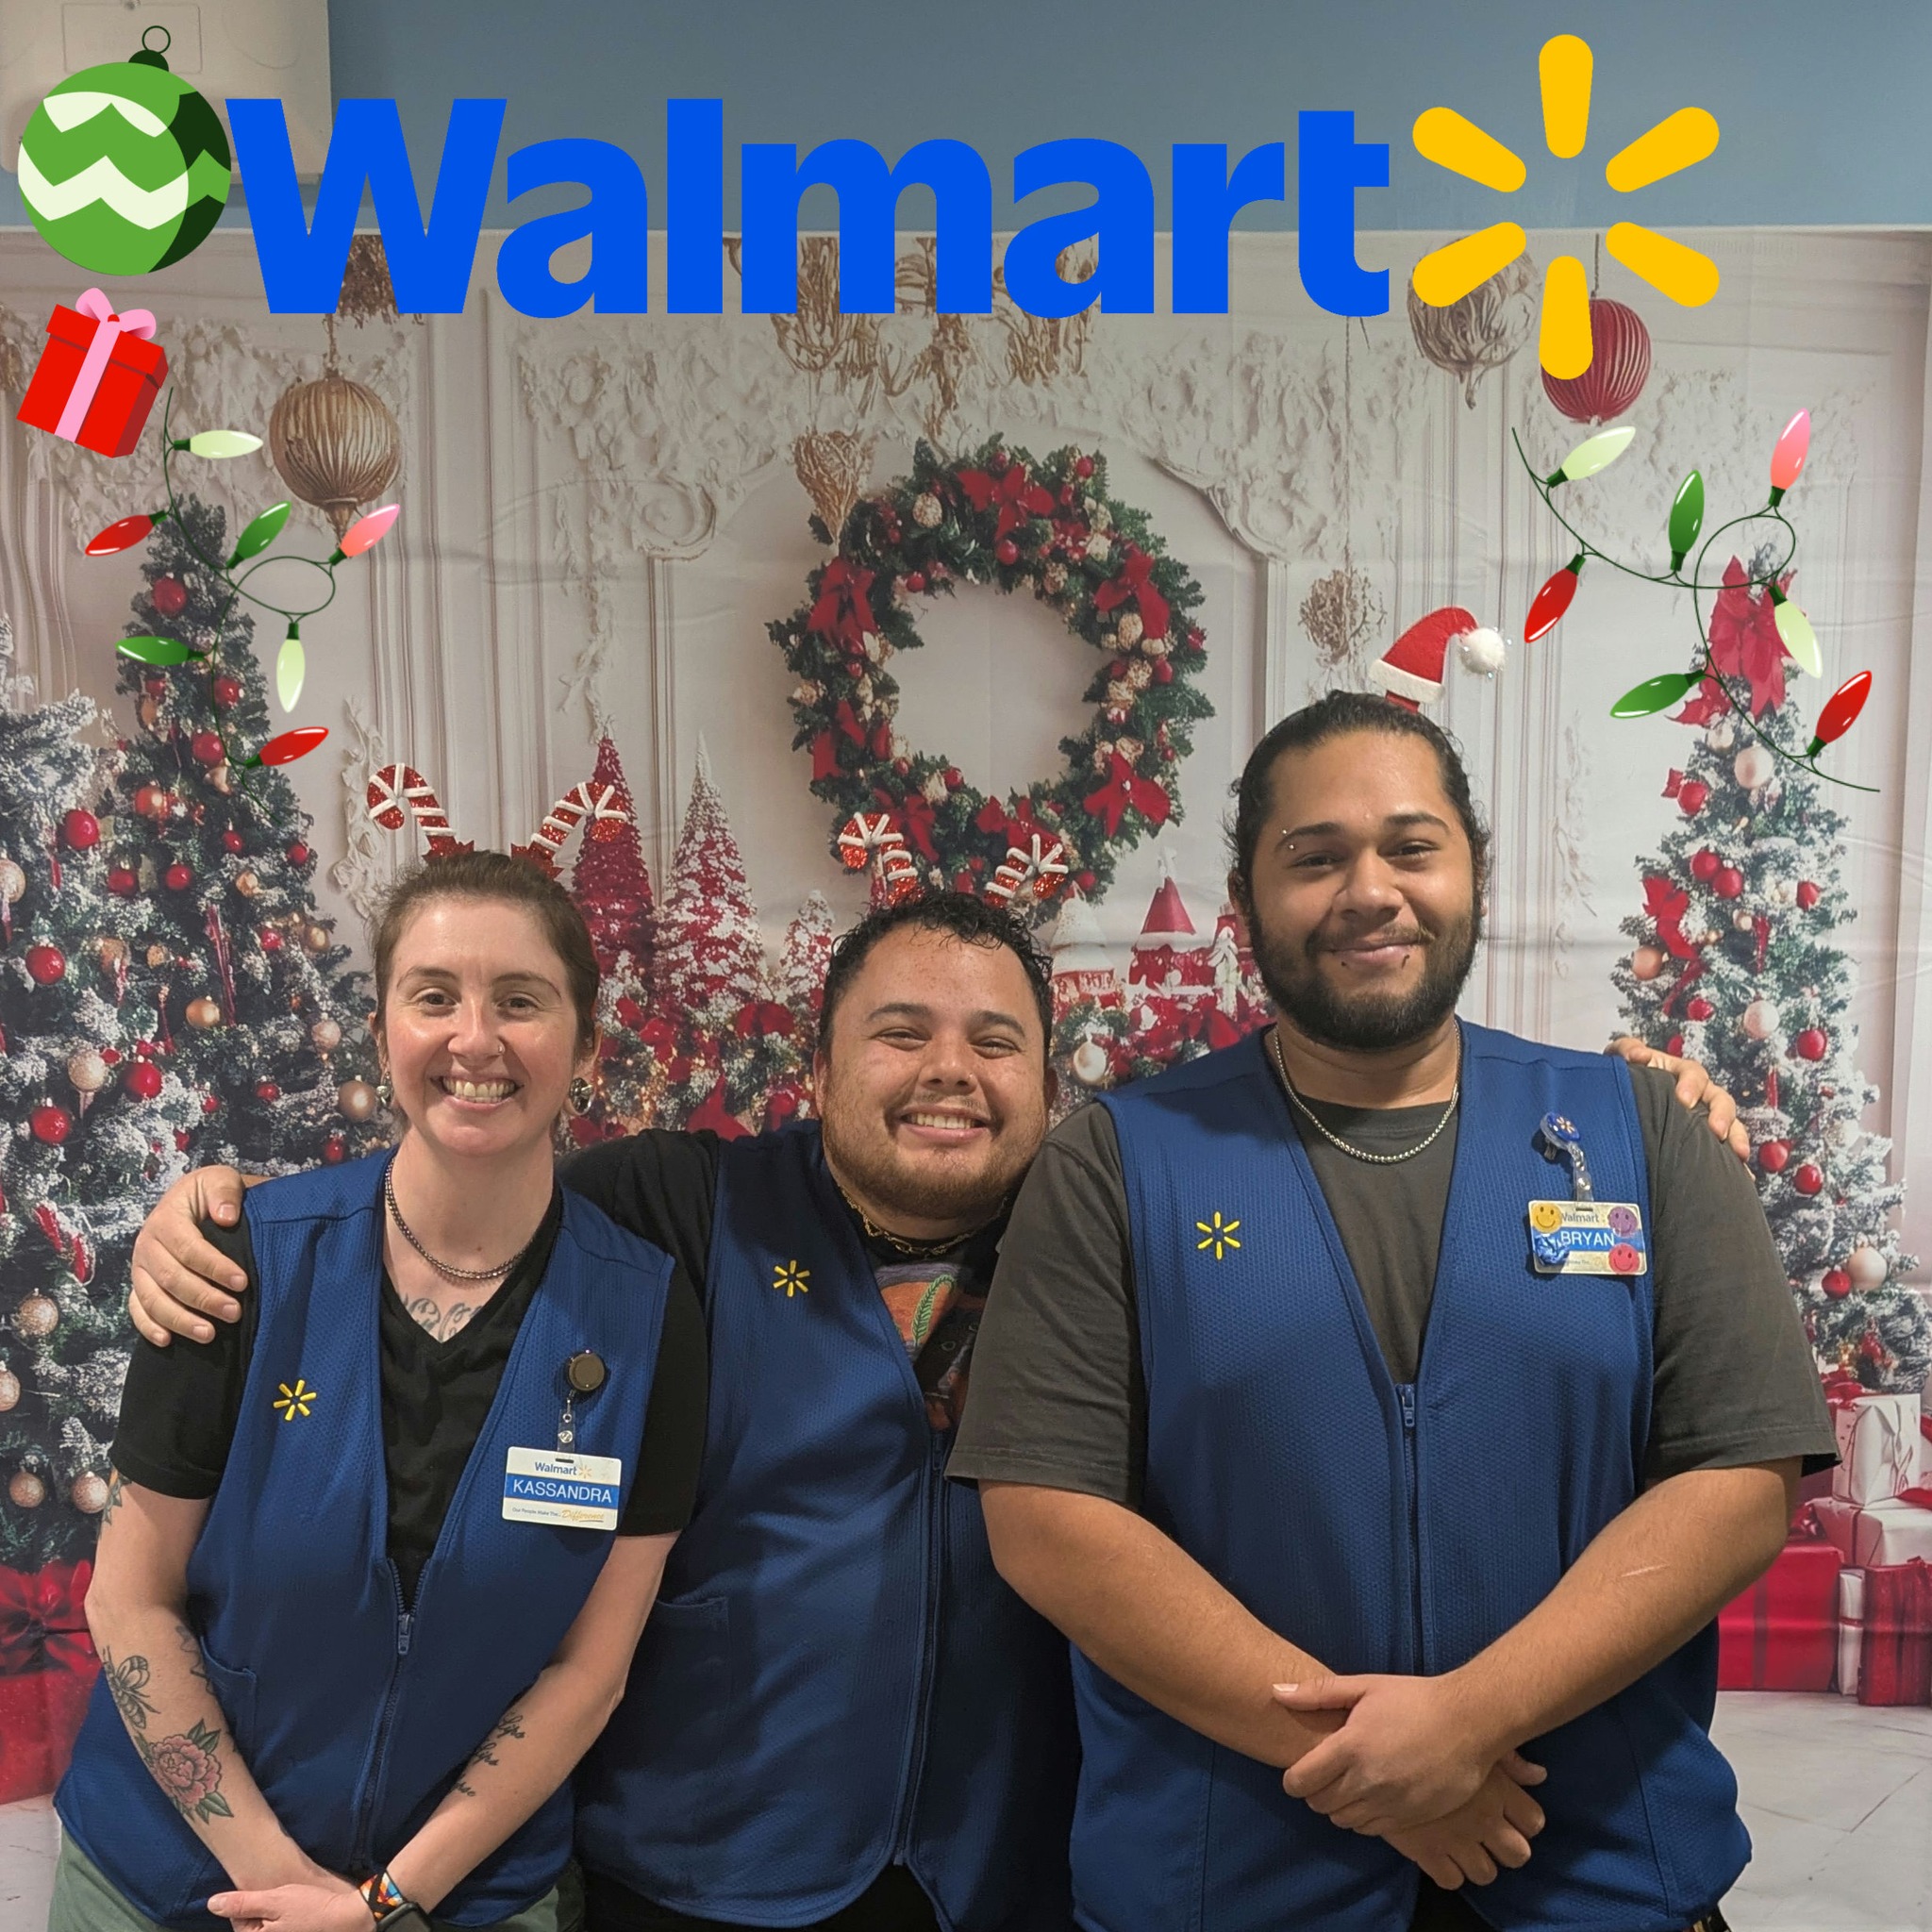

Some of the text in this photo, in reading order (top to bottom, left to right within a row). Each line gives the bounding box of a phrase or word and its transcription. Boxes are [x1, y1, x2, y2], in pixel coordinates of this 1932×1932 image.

[1560, 1230, 1615, 1246] BRYAN
[535, 1461, 578, 1475] Walmart
[512, 1479, 612, 1503] KASSANDRA
[561, 1509, 605, 1522] Difference
